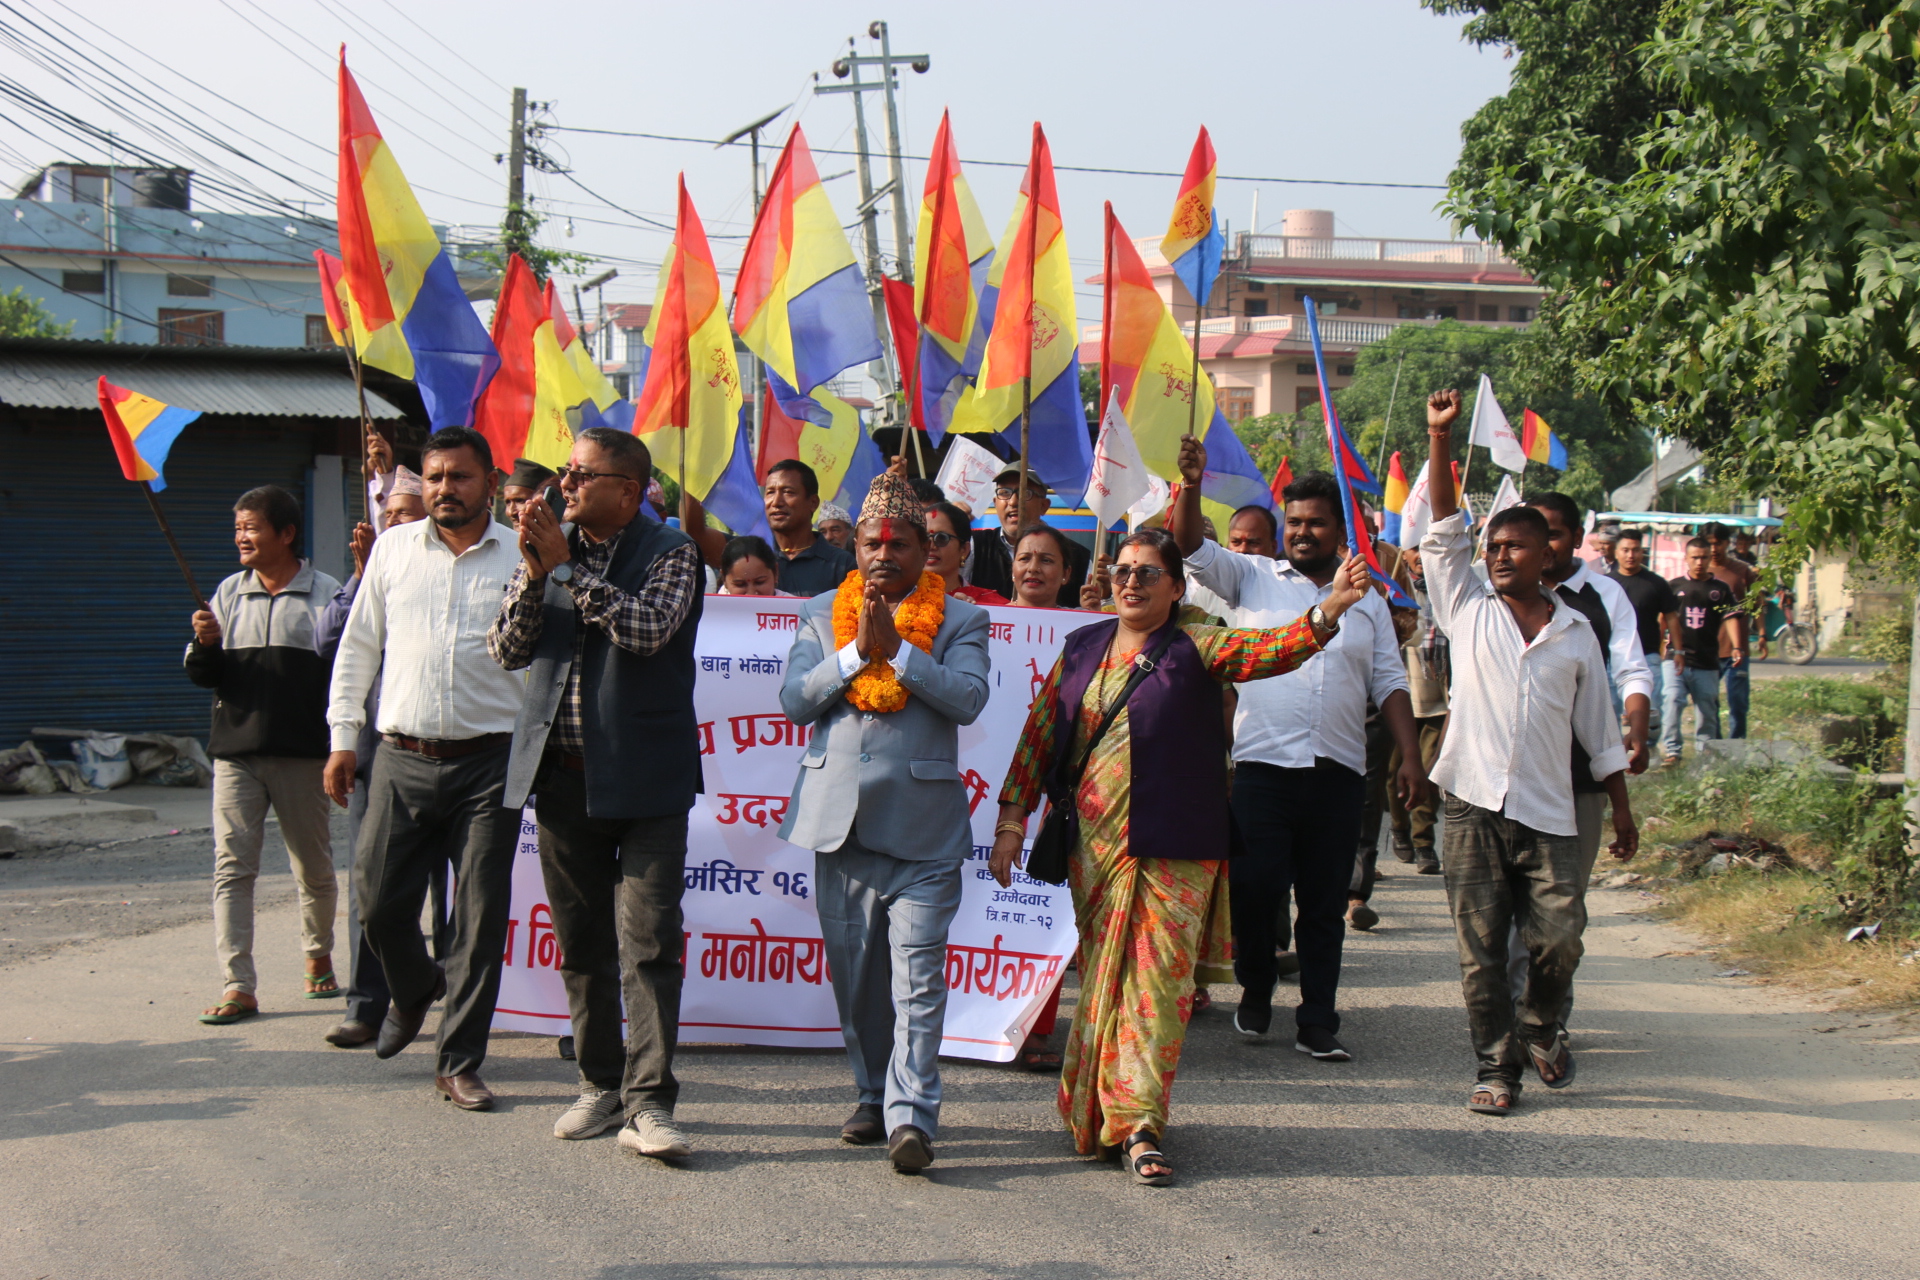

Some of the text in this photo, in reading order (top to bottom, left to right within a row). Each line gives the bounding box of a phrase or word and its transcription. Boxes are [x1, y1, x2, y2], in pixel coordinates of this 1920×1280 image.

[756, 612, 799, 632] प्रजात
[988, 622, 1016, 643] वाद
[701, 656, 732, 679] खानु
[739, 654, 783, 675] भनेको
[727, 713, 814, 755] प्रजा
[685, 859, 808, 900] मंसिर १६
[992, 888, 1052, 908] उम्मेदवार
[700, 918, 833, 986] मनोनय
